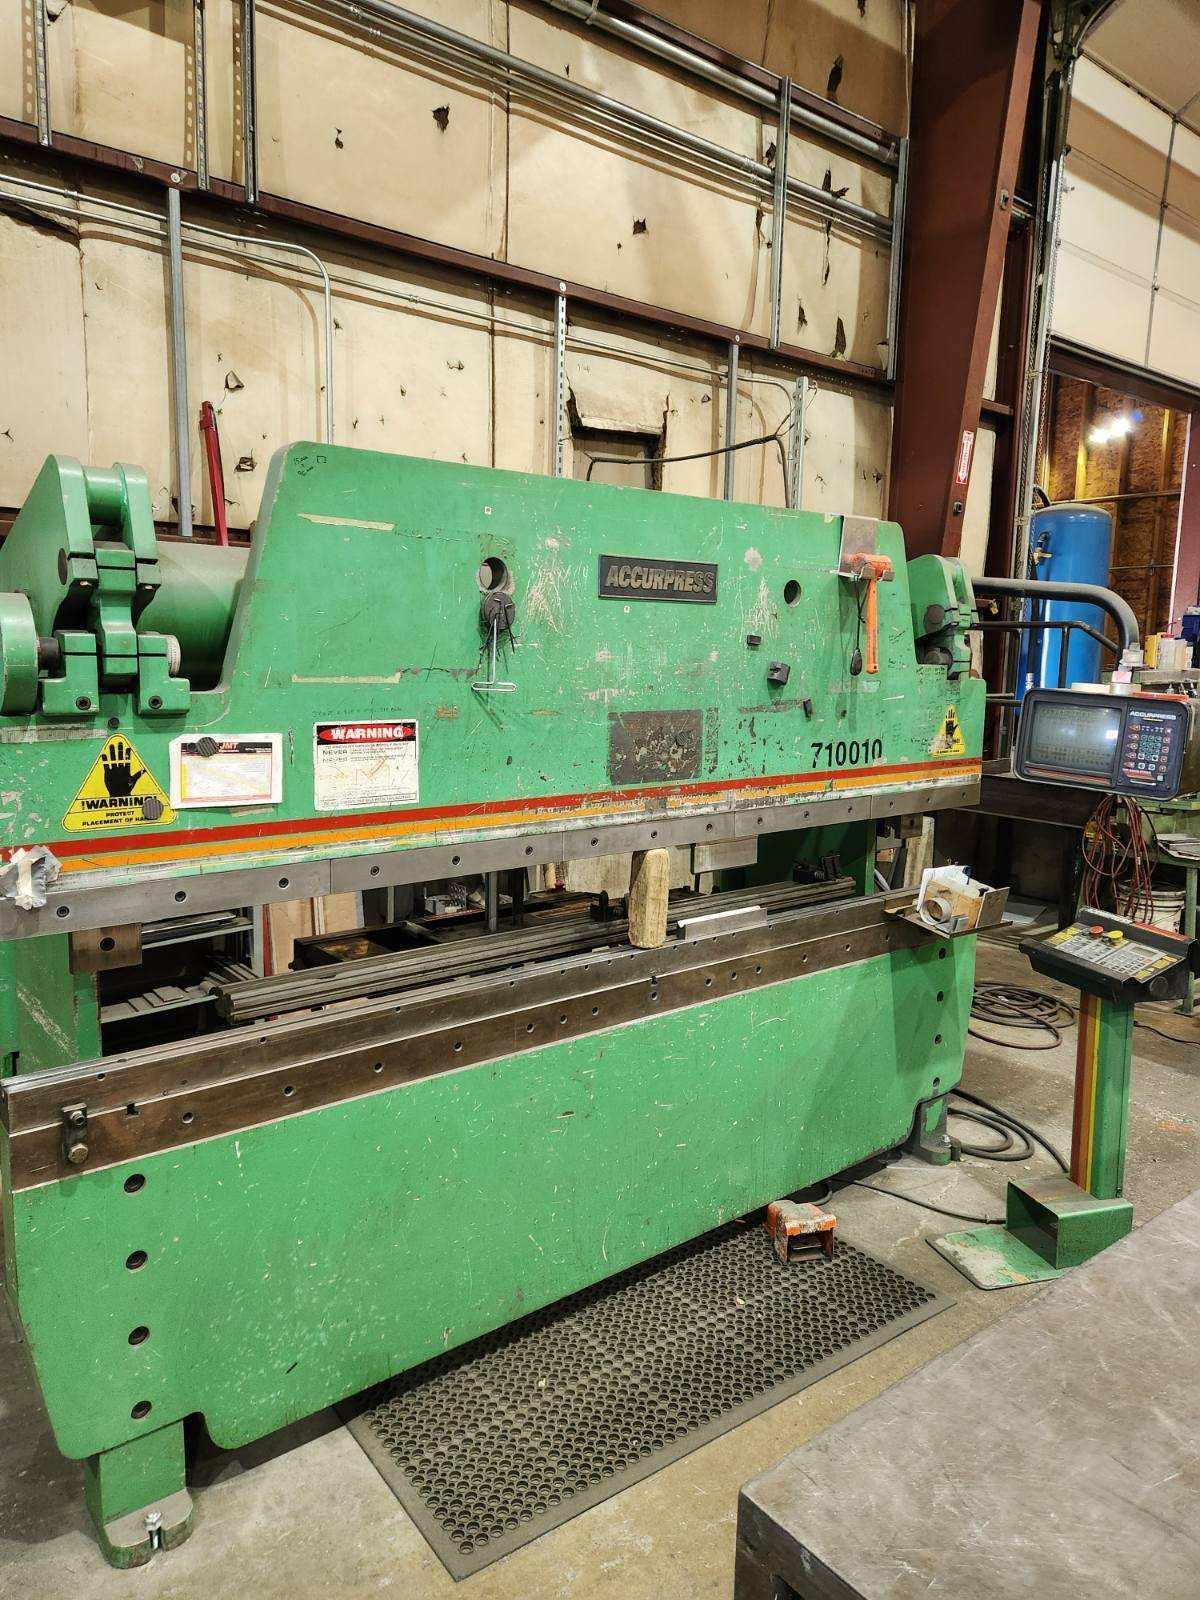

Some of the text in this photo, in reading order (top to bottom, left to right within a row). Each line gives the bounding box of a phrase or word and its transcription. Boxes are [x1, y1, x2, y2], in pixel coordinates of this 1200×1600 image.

[605, 565, 715, 592] ACCURPRESS
[331, 725, 404, 740] WARNING
[810, 738, 883, 768] 710010
[81, 796, 157, 811] !WARNIN
[82, 818, 122, 827] PLACEMENT
